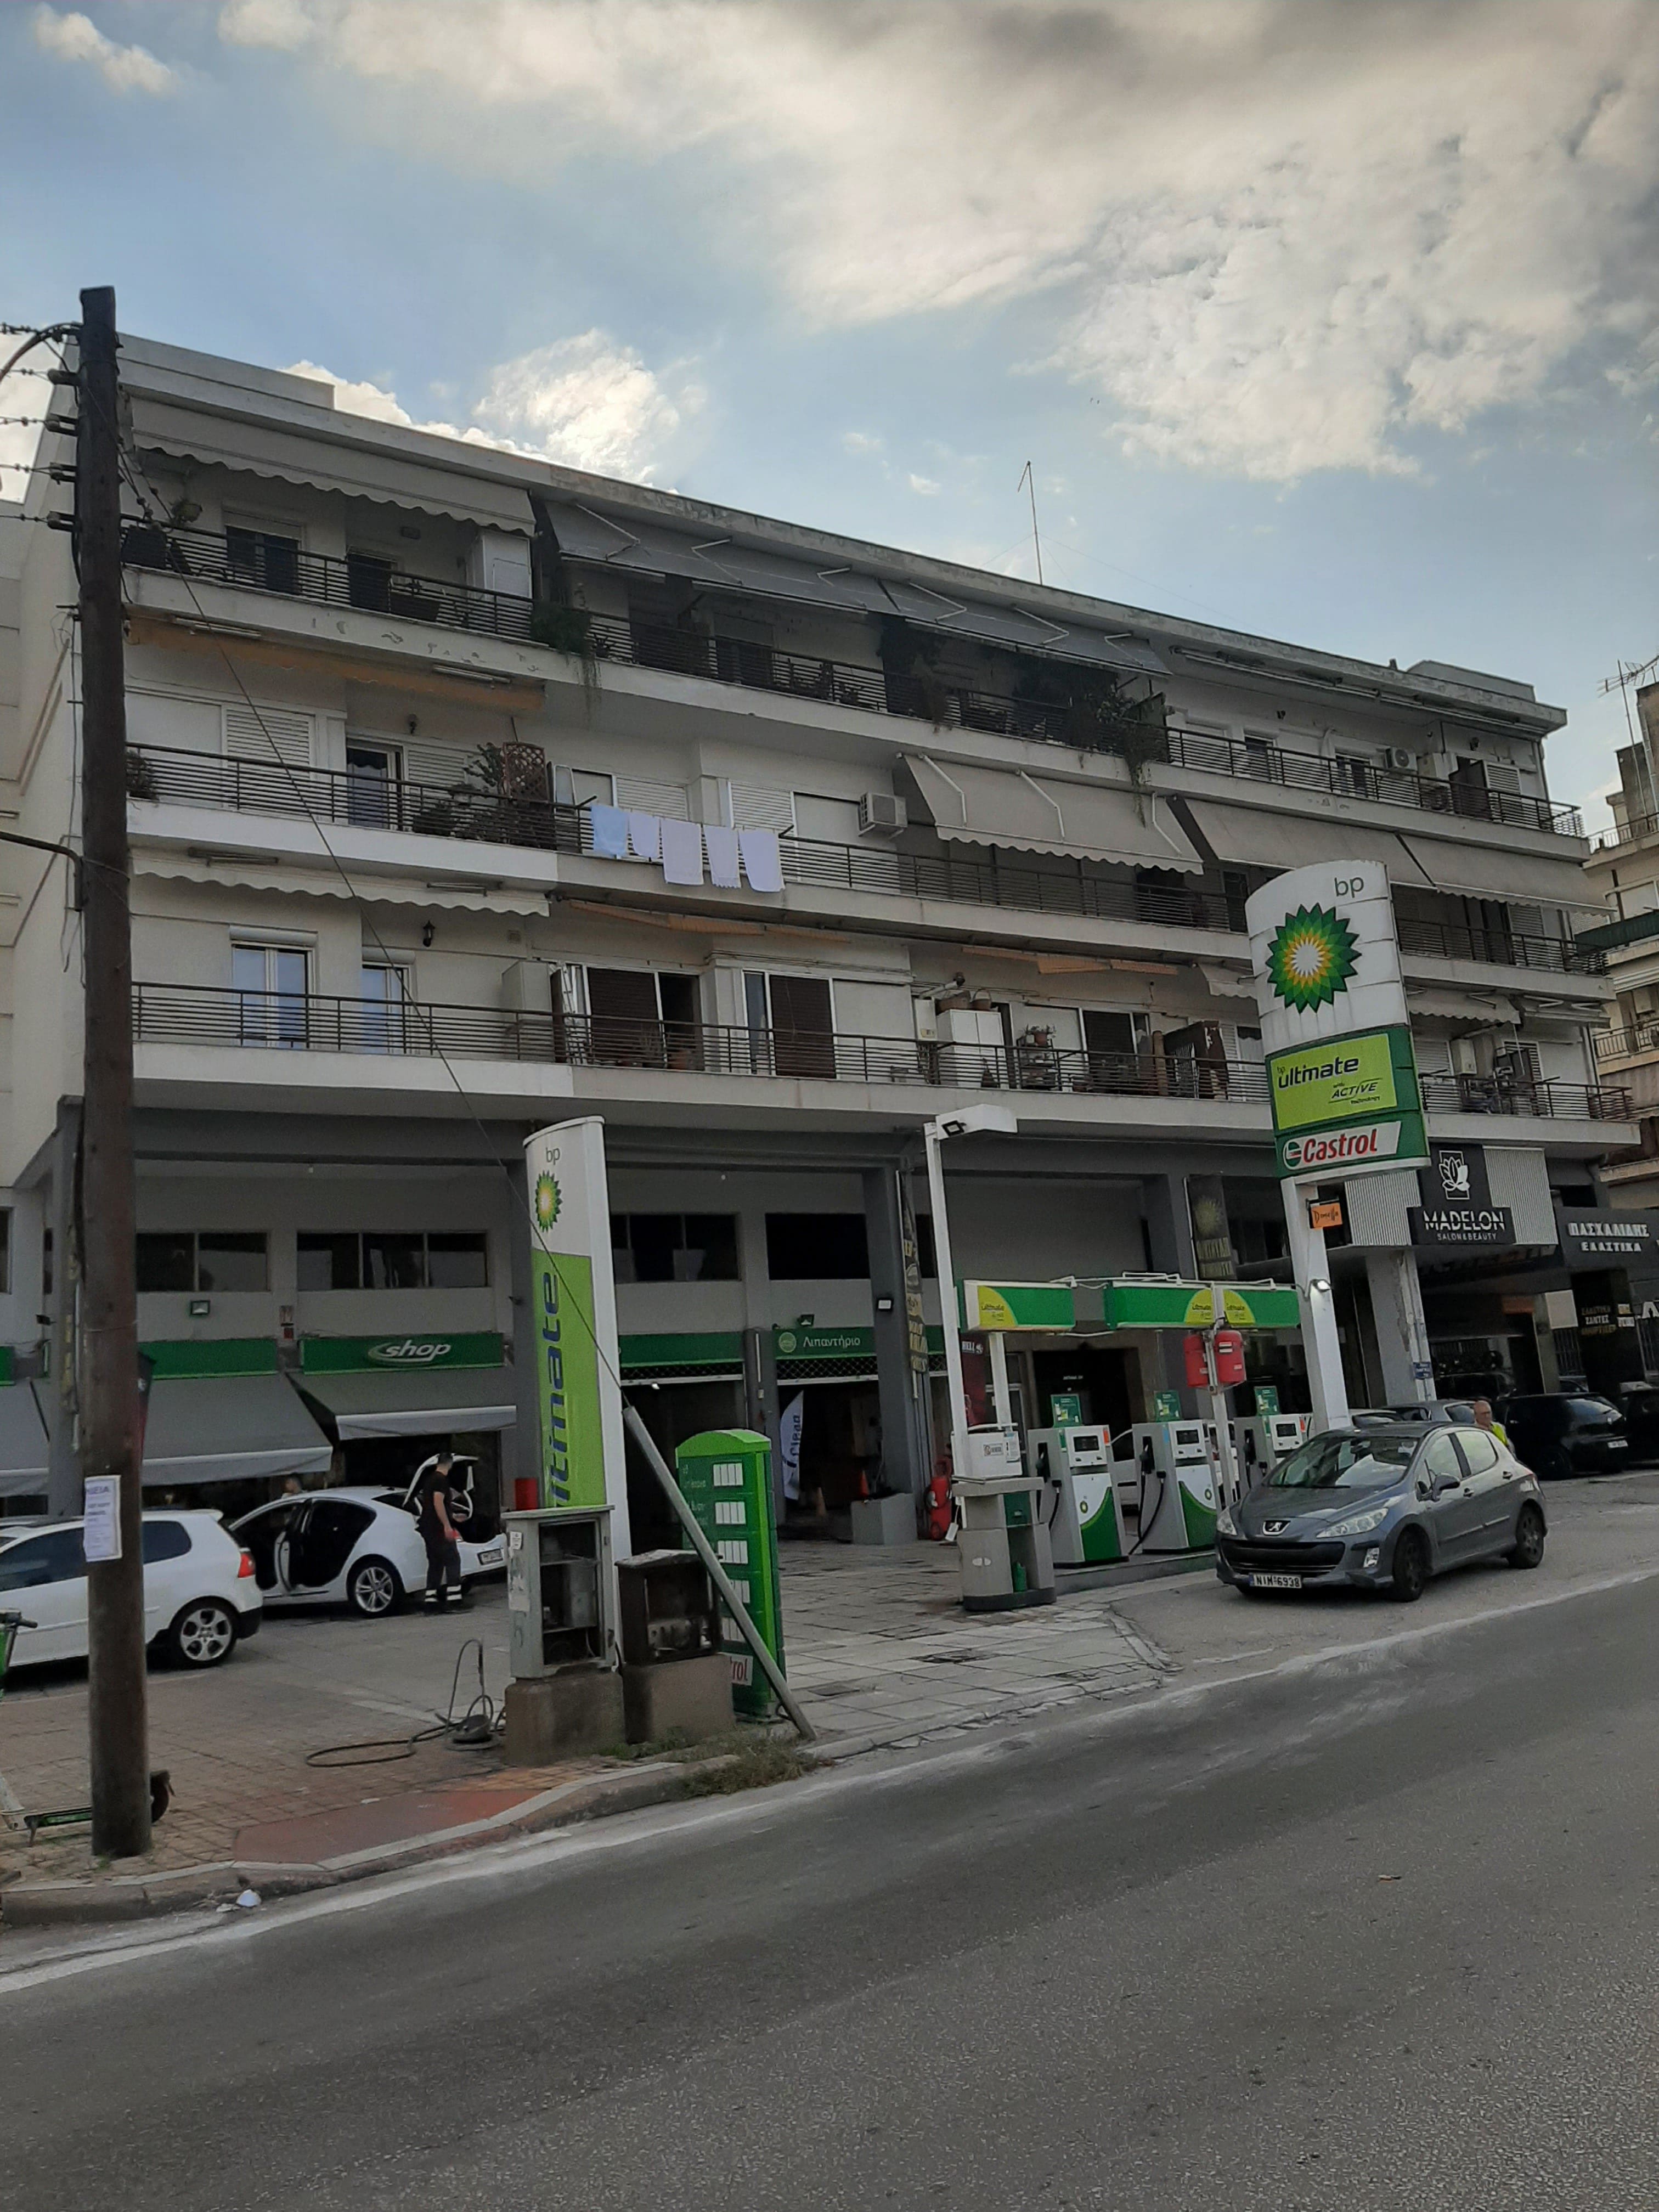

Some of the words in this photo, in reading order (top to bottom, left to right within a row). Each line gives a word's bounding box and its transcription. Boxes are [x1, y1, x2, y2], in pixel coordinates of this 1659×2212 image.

[1334, 877, 1364, 898] bp
[1278, 1057, 1359, 1089] ultimate
[1331, 1081, 1379, 1099] ACTIVE
[1303, 1128, 1378, 1163] Castrol
[545, 1147, 560, 1165] bp
[1423, 1210, 1505, 1231] MADELON
[1568, 1222, 1650, 1237] ΠΑΣΧΑΛΙΔΗΣ
[1581, 1242, 1642, 1252] ΕΛΑΣΤΙΚΑ
[386, 1339, 452, 1361] shop
[803, 1335, 861, 1349] Λιπαντήριο
